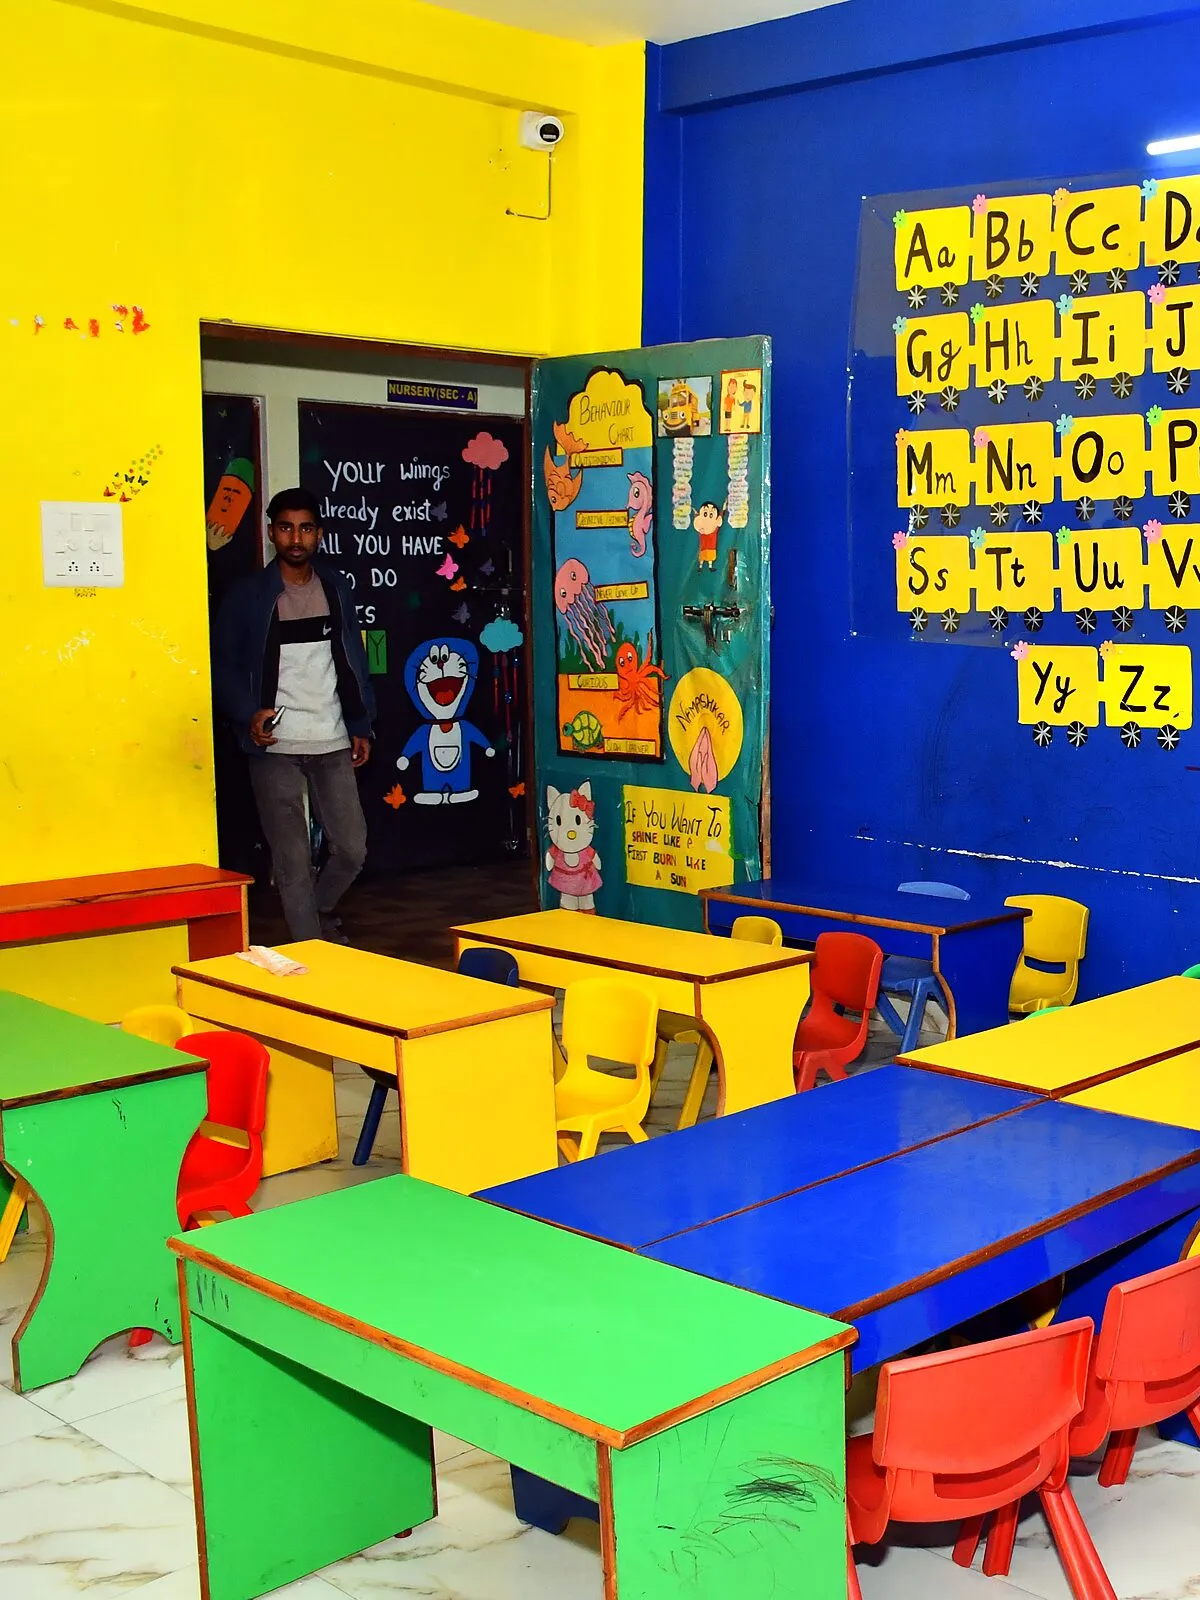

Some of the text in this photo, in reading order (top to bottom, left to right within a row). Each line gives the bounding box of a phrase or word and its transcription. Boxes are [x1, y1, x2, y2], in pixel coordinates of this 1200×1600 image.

[580, 395, 631, 425] BEHAVIOUR
[609, 423, 634, 445] CHART
[392, 499, 431, 521] exist
[353, 534, 390, 555] YOU
[402, 536, 443, 555] HAVE
[371, 568, 397, 587] DO
[577, 675, 609, 689] CURIOUS
[676, 693, 730, 735] NAMASHKAR
[632, 831, 658, 844] SHINE
[663, 834, 681, 848] LIKE
[627, 845, 706, 870] FIRST BURN LIKE
[655, 870, 687, 887] A SUN
